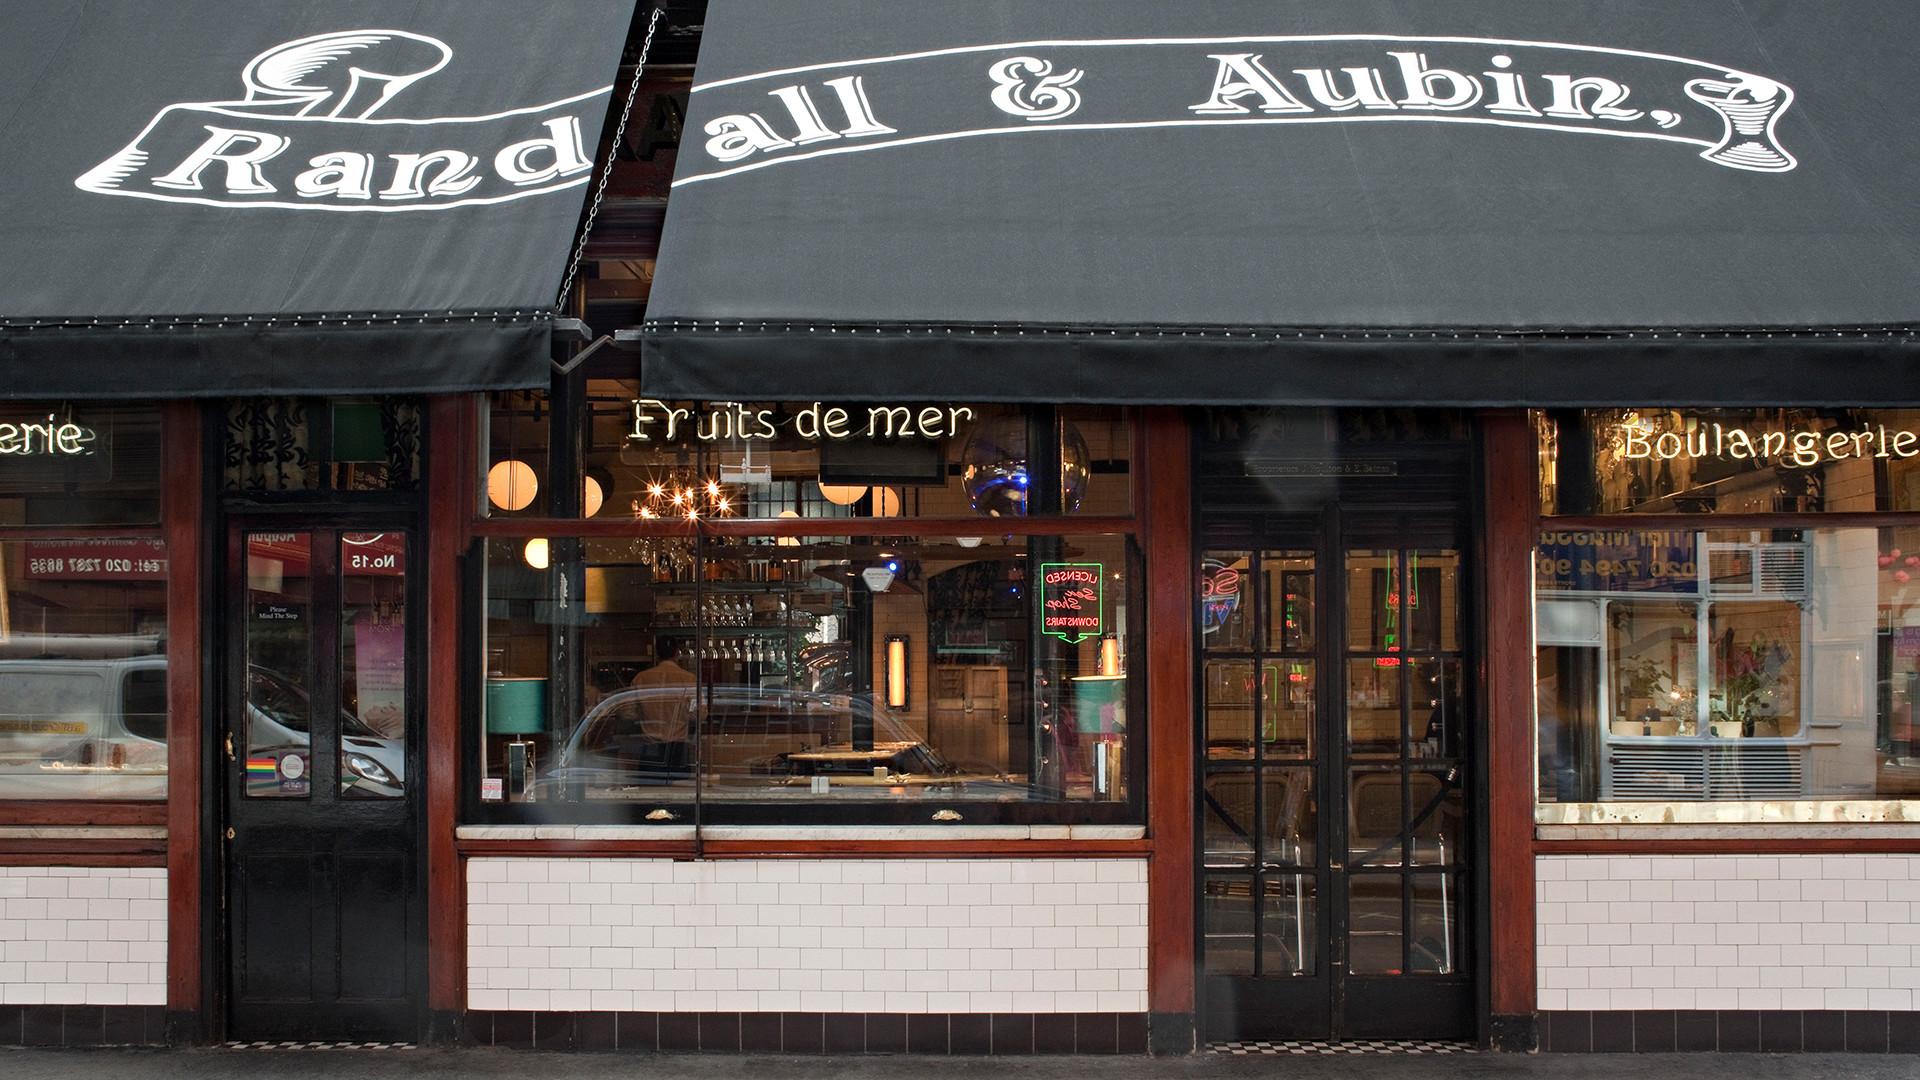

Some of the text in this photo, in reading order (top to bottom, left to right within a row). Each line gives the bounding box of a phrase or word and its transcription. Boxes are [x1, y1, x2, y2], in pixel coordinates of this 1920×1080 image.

[989, 57, 1084, 121] &
[629, 399, 973, 439] Fruits de mer
[1622, 422, 1919, 466] Boulangerie
